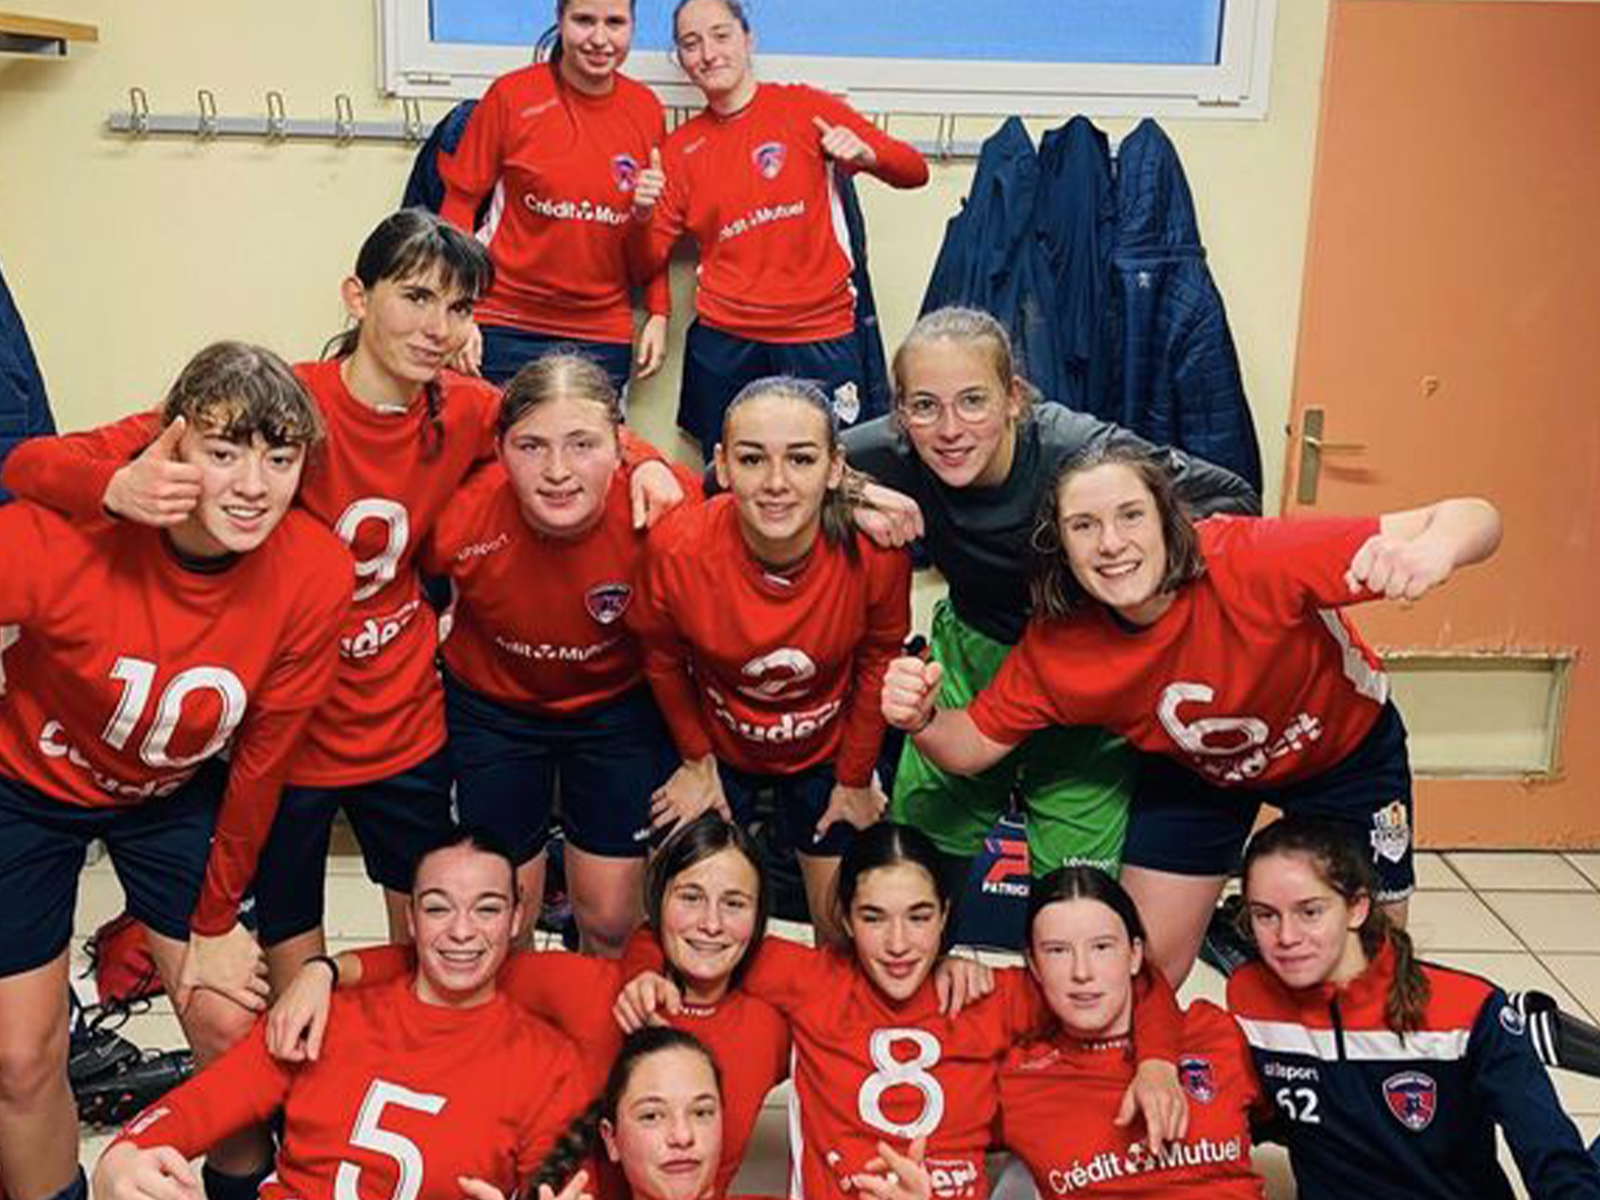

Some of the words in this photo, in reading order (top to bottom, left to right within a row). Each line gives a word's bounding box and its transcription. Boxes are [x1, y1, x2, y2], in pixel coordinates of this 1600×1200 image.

[335, 497, 410, 601] 9
[102, 656, 248, 769] 10
[1156, 681, 1269, 755] 6
[859, 1027, 945, 1140] 8
[334, 1078, 448, 1200] 5
[1049, 1151, 1122, 1195] Crédit
[1160, 1136, 1242, 1170] Mutuel
